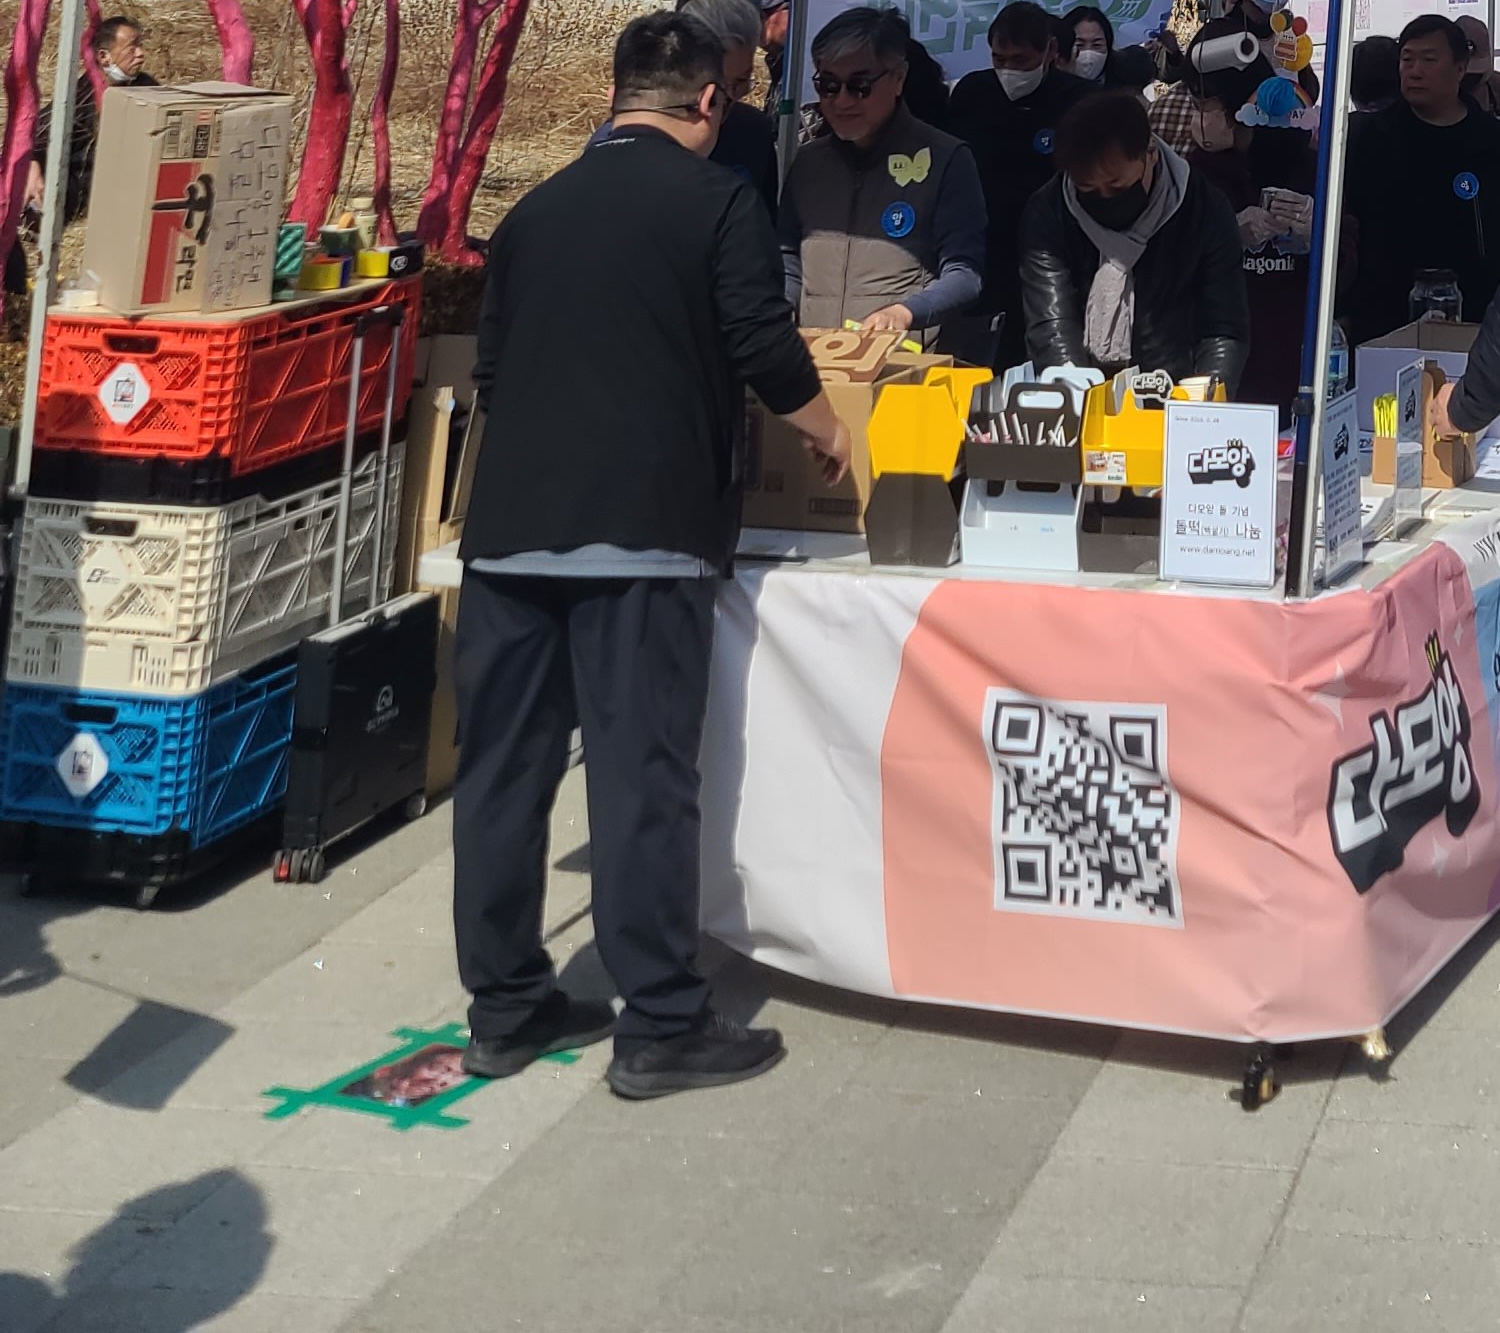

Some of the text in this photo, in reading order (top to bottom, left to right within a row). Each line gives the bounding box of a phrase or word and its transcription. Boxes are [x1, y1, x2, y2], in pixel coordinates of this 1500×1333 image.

[1190, 447, 1251, 478] 다모앙
[1188, 503, 1215, 517] 다모앙
[1231, 506, 1249, 518] 기념
[1235, 523, 1262, 540] 나눔
[1333, 658, 1472, 854] 다모앙
